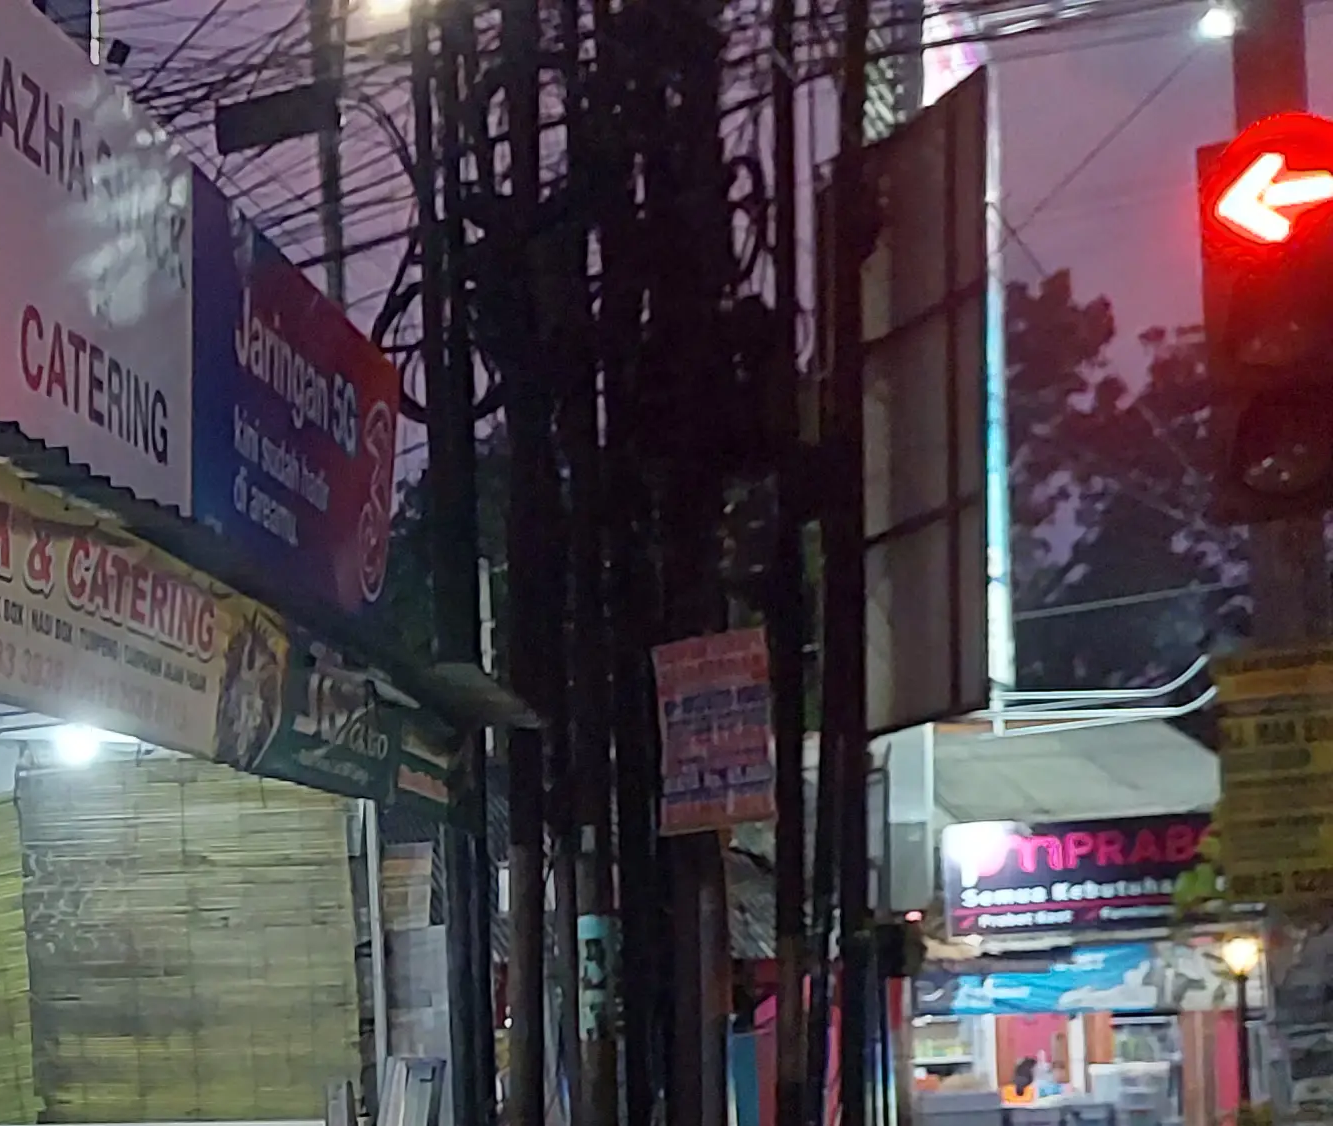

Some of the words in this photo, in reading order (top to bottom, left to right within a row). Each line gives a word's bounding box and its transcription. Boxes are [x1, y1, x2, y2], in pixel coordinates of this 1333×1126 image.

[19, 305, 169, 466] CATERING
[234, 286, 330, 433] Jaringan
[332, 372, 358, 459] 5G
[3, 594, 24, 627] BOX
[23, 531, 55, 599] &
[66, 536, 216, 663] CATERING
[1051, 876, 1176, 902] Kebutuha
